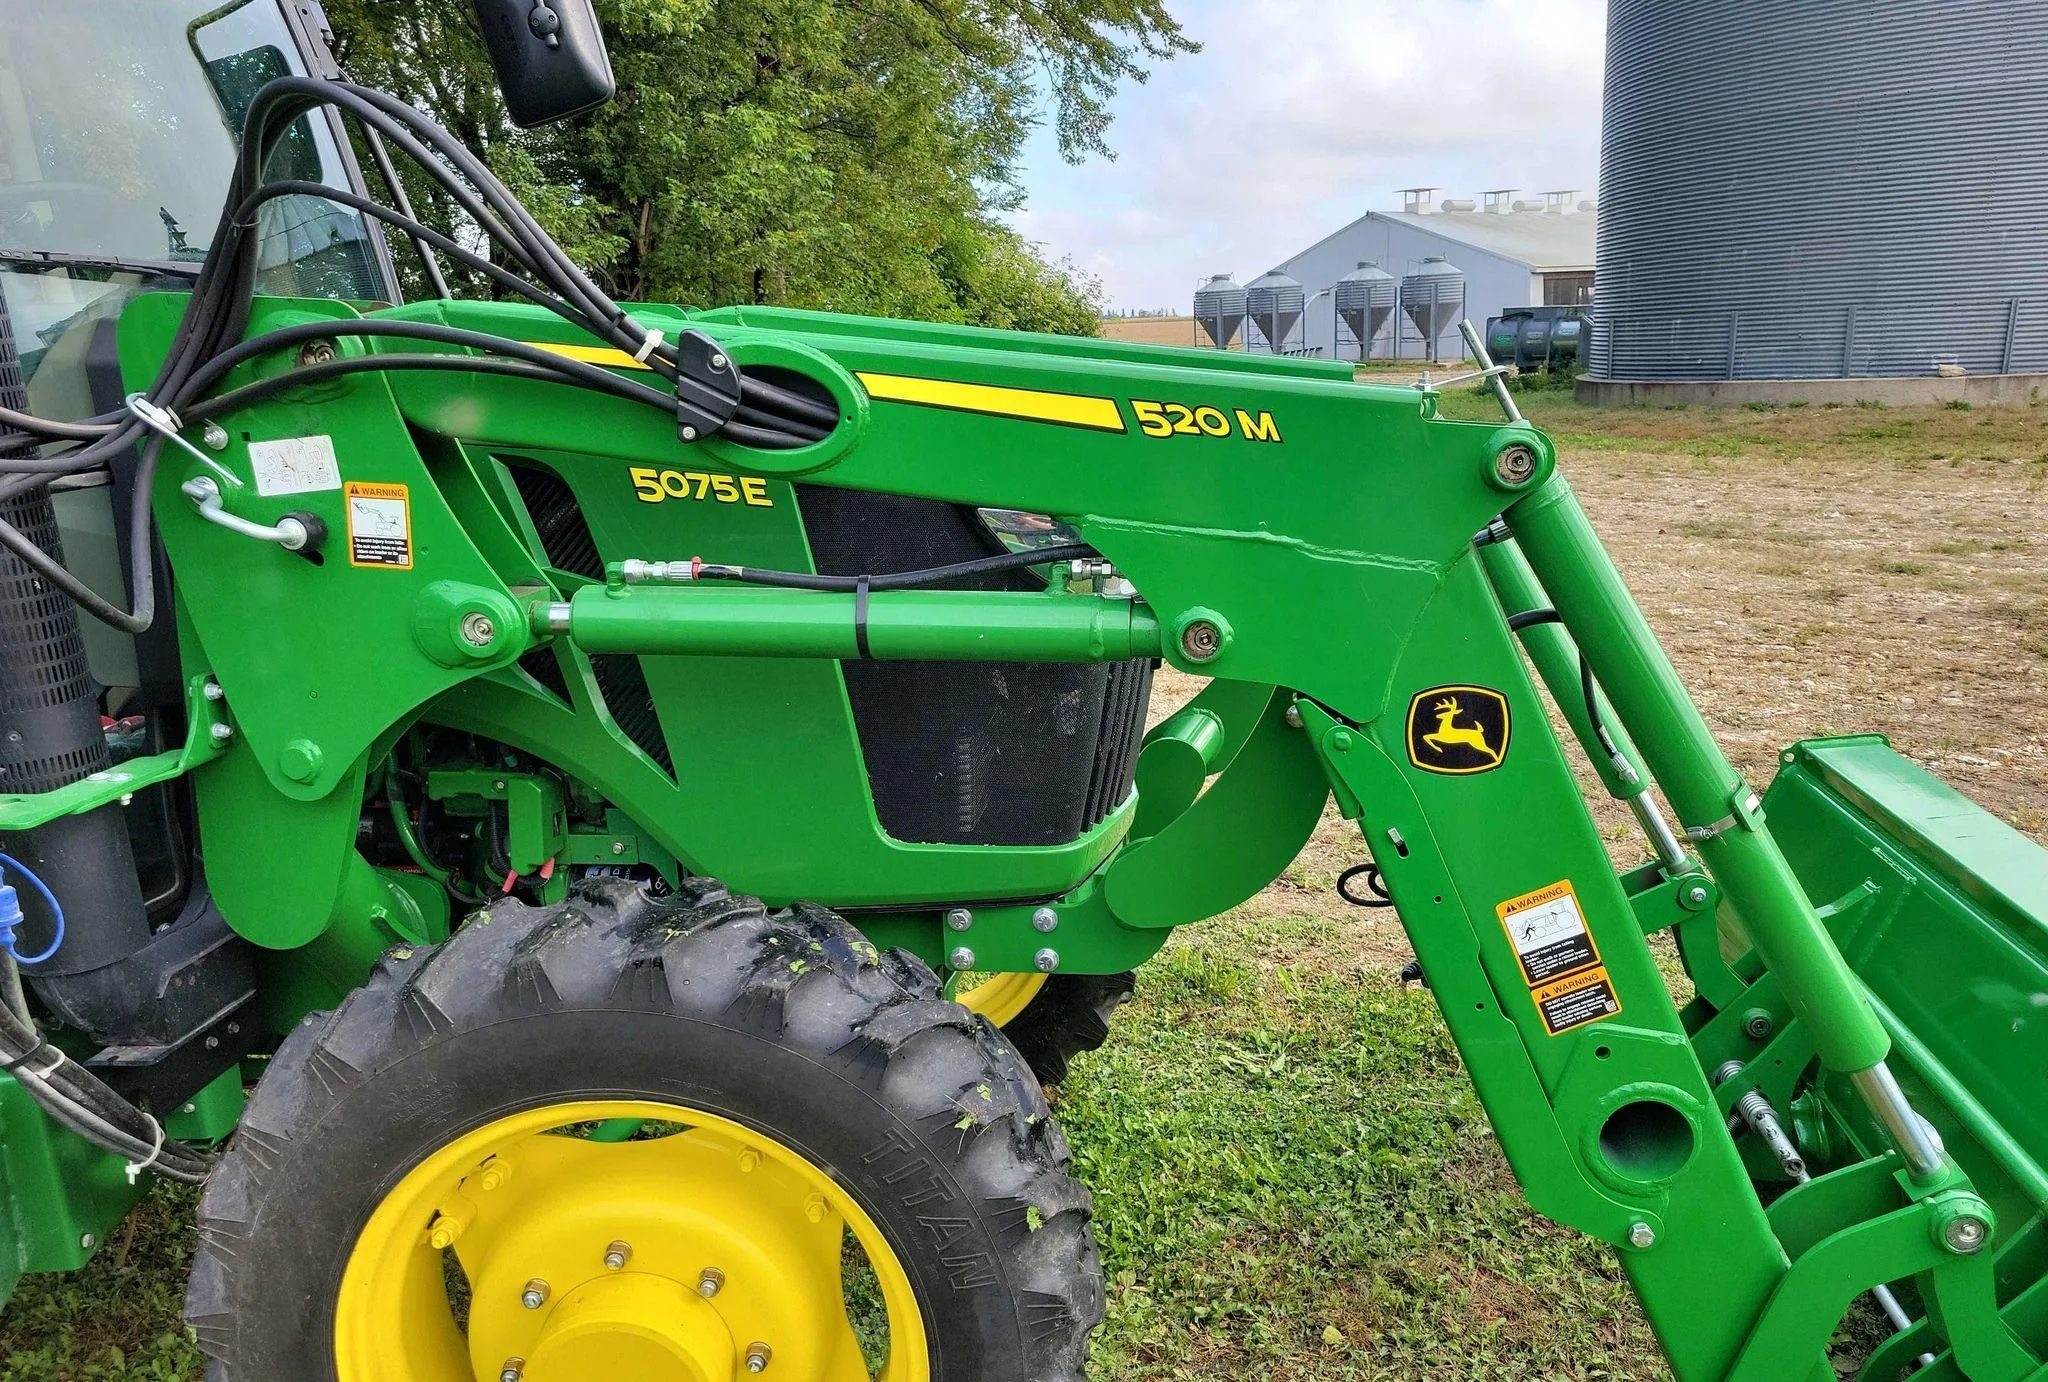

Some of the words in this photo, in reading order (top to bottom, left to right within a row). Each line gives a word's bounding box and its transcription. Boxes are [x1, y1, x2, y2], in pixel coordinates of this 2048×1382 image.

[1128, 398, 1232, 439] 520
[1232, 408, 1284, 443] M
[362, 488, 404, 497] WARNING
[628, 466, 774, 507] 5075E
[1517, 887, 1563, 908] WARNING
[1553, 973, 1599, 993] WARNING
[860, 1127, 999, 1292] TITAN
